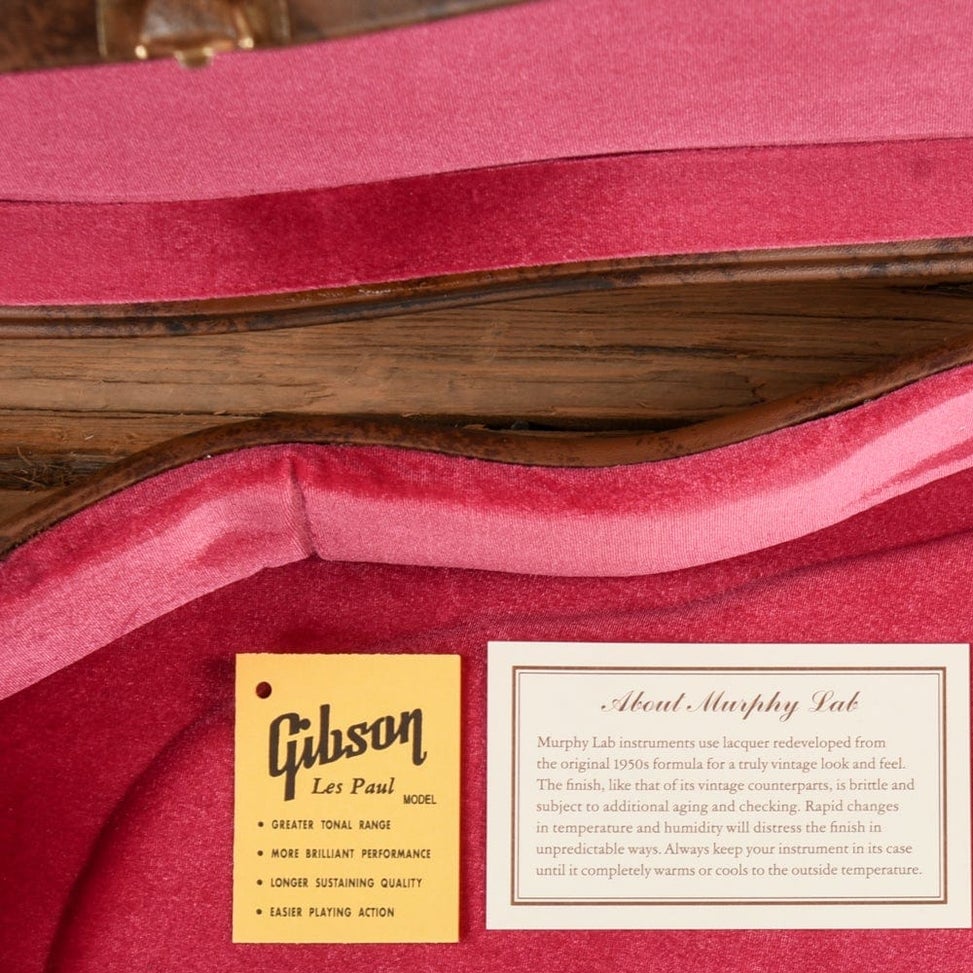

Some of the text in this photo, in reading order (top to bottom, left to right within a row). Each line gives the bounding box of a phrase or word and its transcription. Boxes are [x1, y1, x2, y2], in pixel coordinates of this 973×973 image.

[600, 690, 860, 721] About Murphy Lab
[268, 703, 428, 801] Gibson
[537, 735, 886, 753] Murphy Lab instruments use lacquer redeveloped from
[310, 776, 395, 795] Les Paul
[402, 793, 437, 805] MODEL
[536, 799, 899, 817] subject to additional aging and checking. Rapid changes
[271, 819, 391, 830] GREATER TONAL RANGE
[270, 848, 431, 859] MORE BRILLIANT PERFORMANCE
[536, 841, 913, 859] unpredictable ways. Always keep your instrument in its case
[270, 877, 422, 888] LONGER SUSTAINING QUALITY
[269, 906, 394, 918] EASIER PLAYING ACTION
